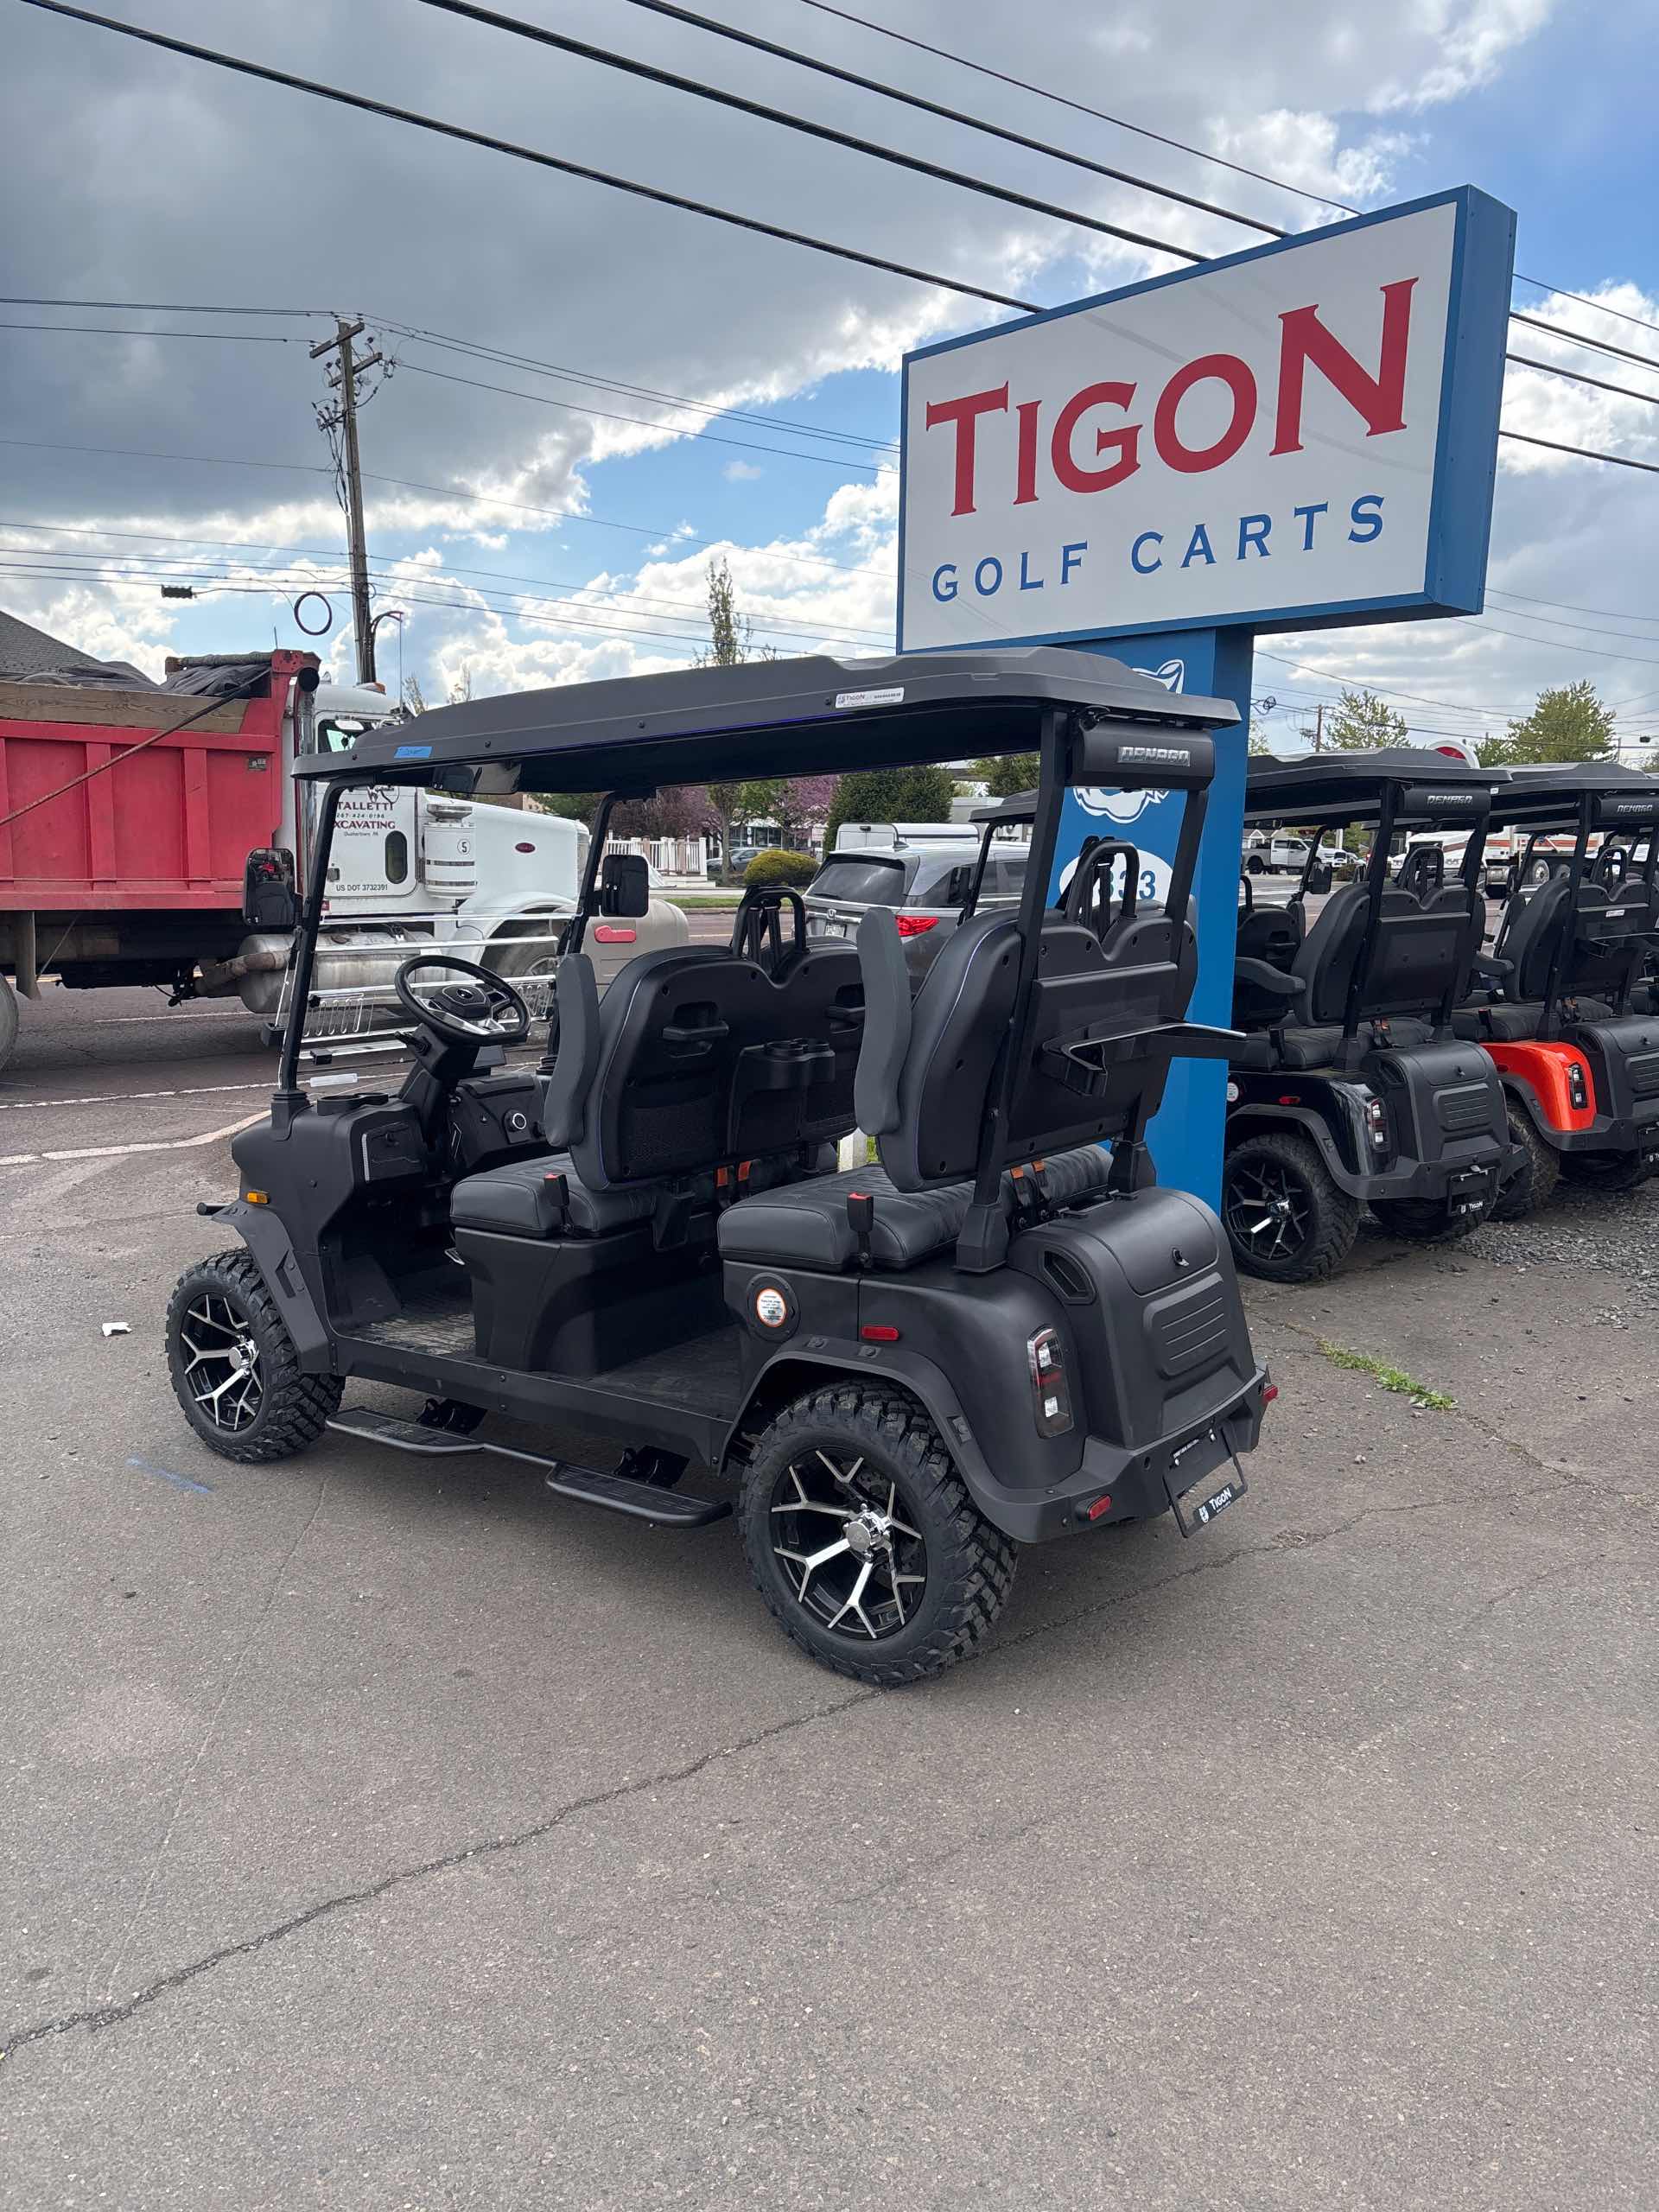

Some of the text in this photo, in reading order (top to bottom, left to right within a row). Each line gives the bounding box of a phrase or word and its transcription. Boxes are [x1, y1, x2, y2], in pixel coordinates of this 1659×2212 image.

[926, 276, 1419, 517] TIGON
[931, 494, 1385, 603] GOLF CARTS
[332, 820, 396, 830] XCAVATING
[1208, 1487, 1232, 1510] TIGON
